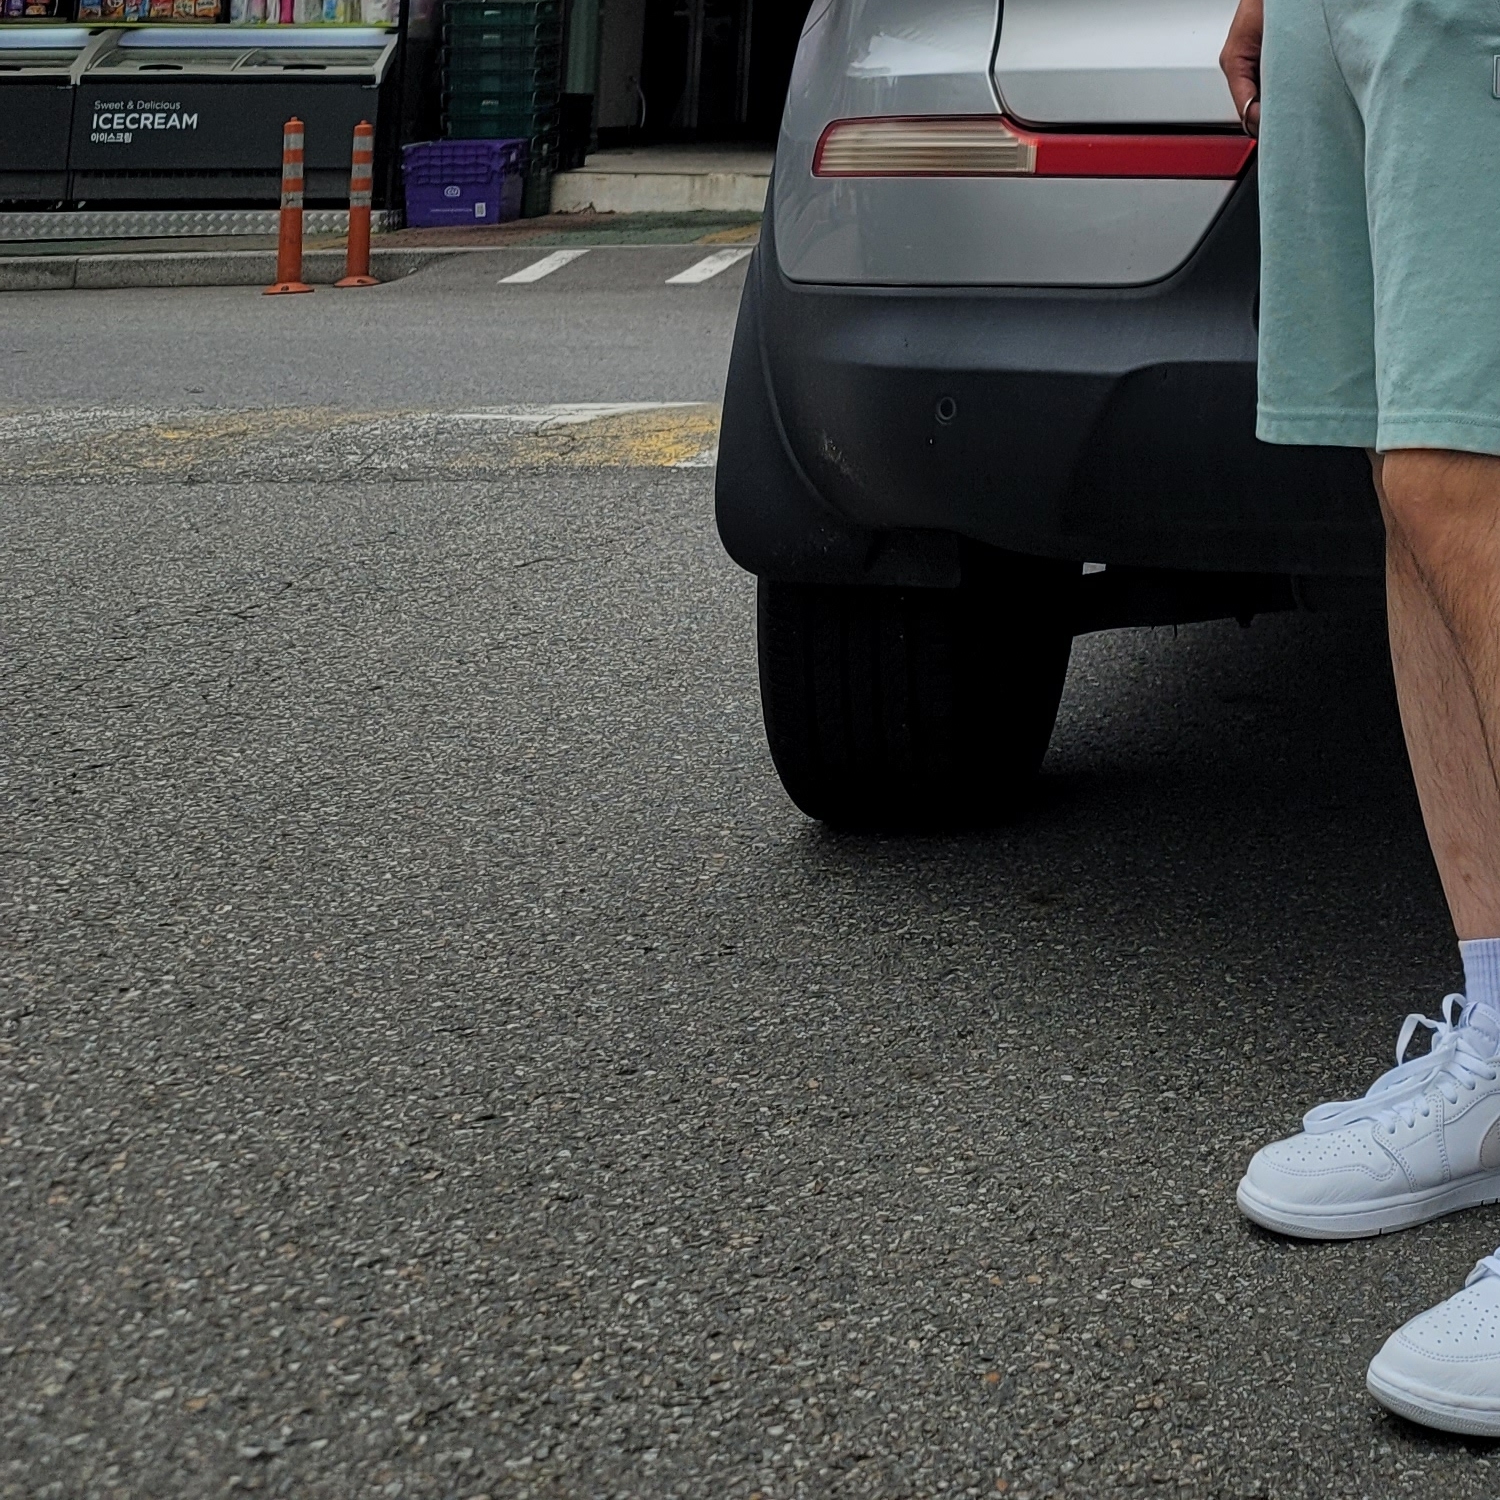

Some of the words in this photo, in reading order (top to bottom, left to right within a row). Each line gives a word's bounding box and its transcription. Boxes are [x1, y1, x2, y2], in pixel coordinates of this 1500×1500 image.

[94, 100, 124, 110] Sweet
[126, 100, 134, 110] &
[136, 100, 181, 110] Delicious
[92, 112, 198, 130] ICECREAM
[90, 132, 132, 143] 아이스크림
